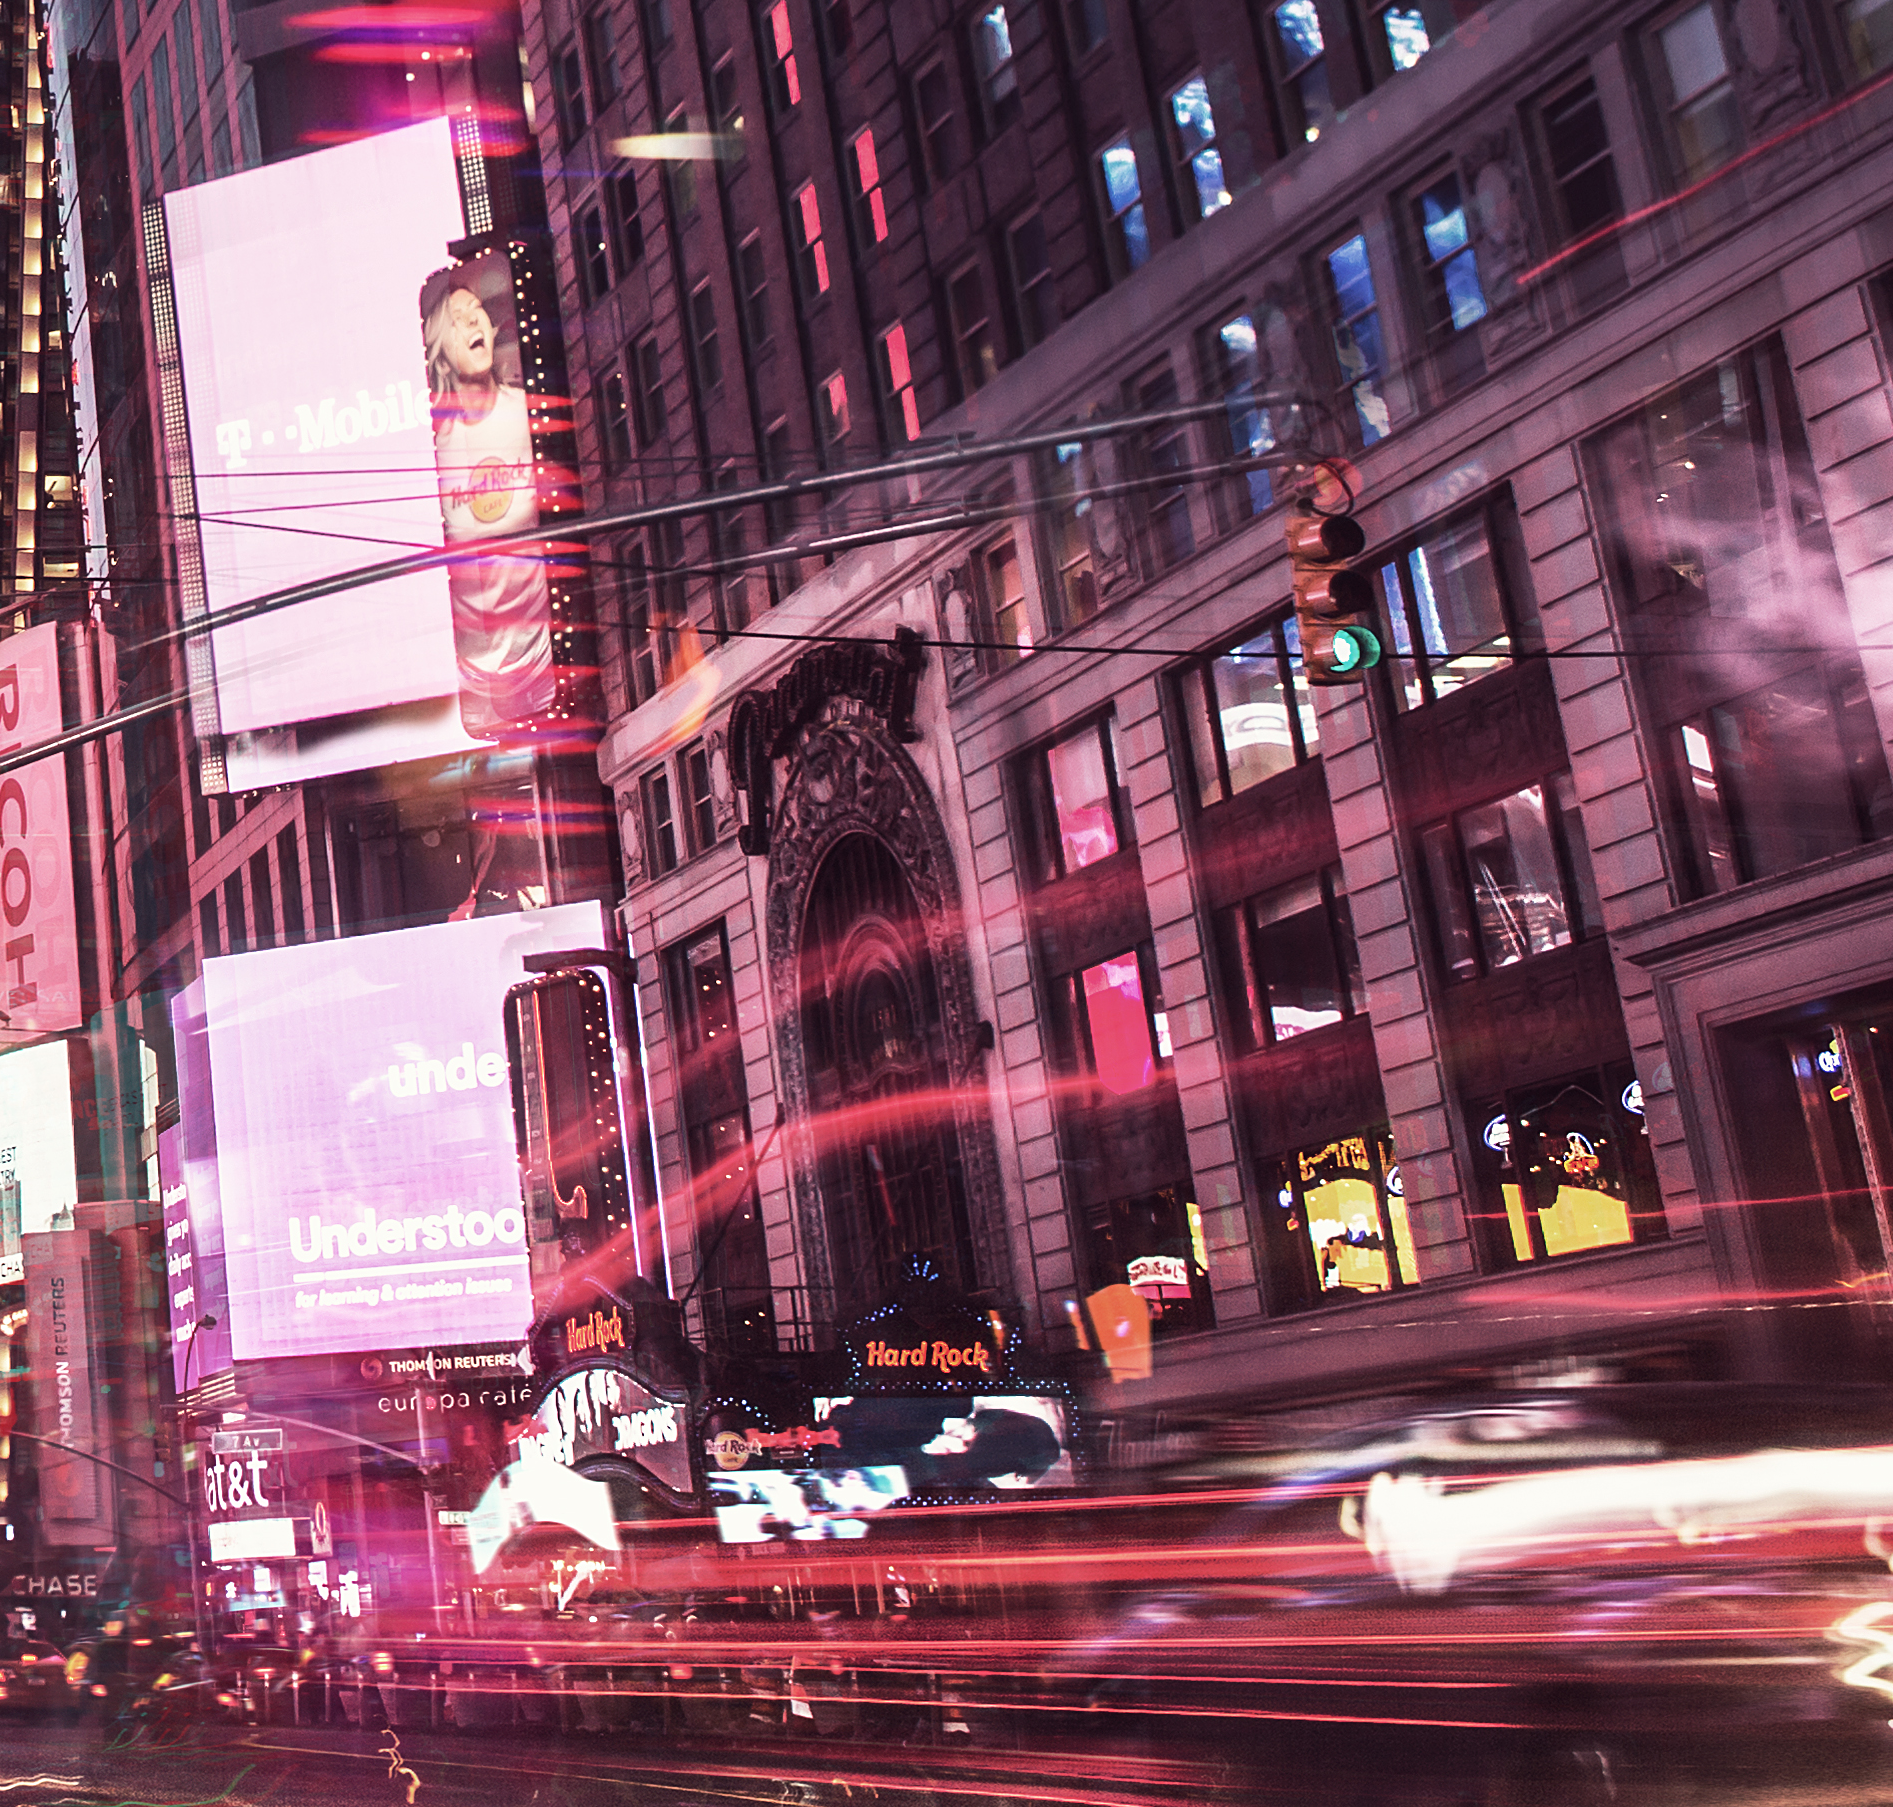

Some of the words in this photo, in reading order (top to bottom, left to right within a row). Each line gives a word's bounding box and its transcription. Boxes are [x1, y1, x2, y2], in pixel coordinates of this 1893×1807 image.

[566, 1312, 596, 1353] Hard
[594, 1305, 625, 1353] Rock
[865, 1340, 928, 1367] Hard
[930, 1340, 990, 1374] Rock
[205, 1450, 270, 1512] at&t
[14, 1574, 98, 1597] CHASE
